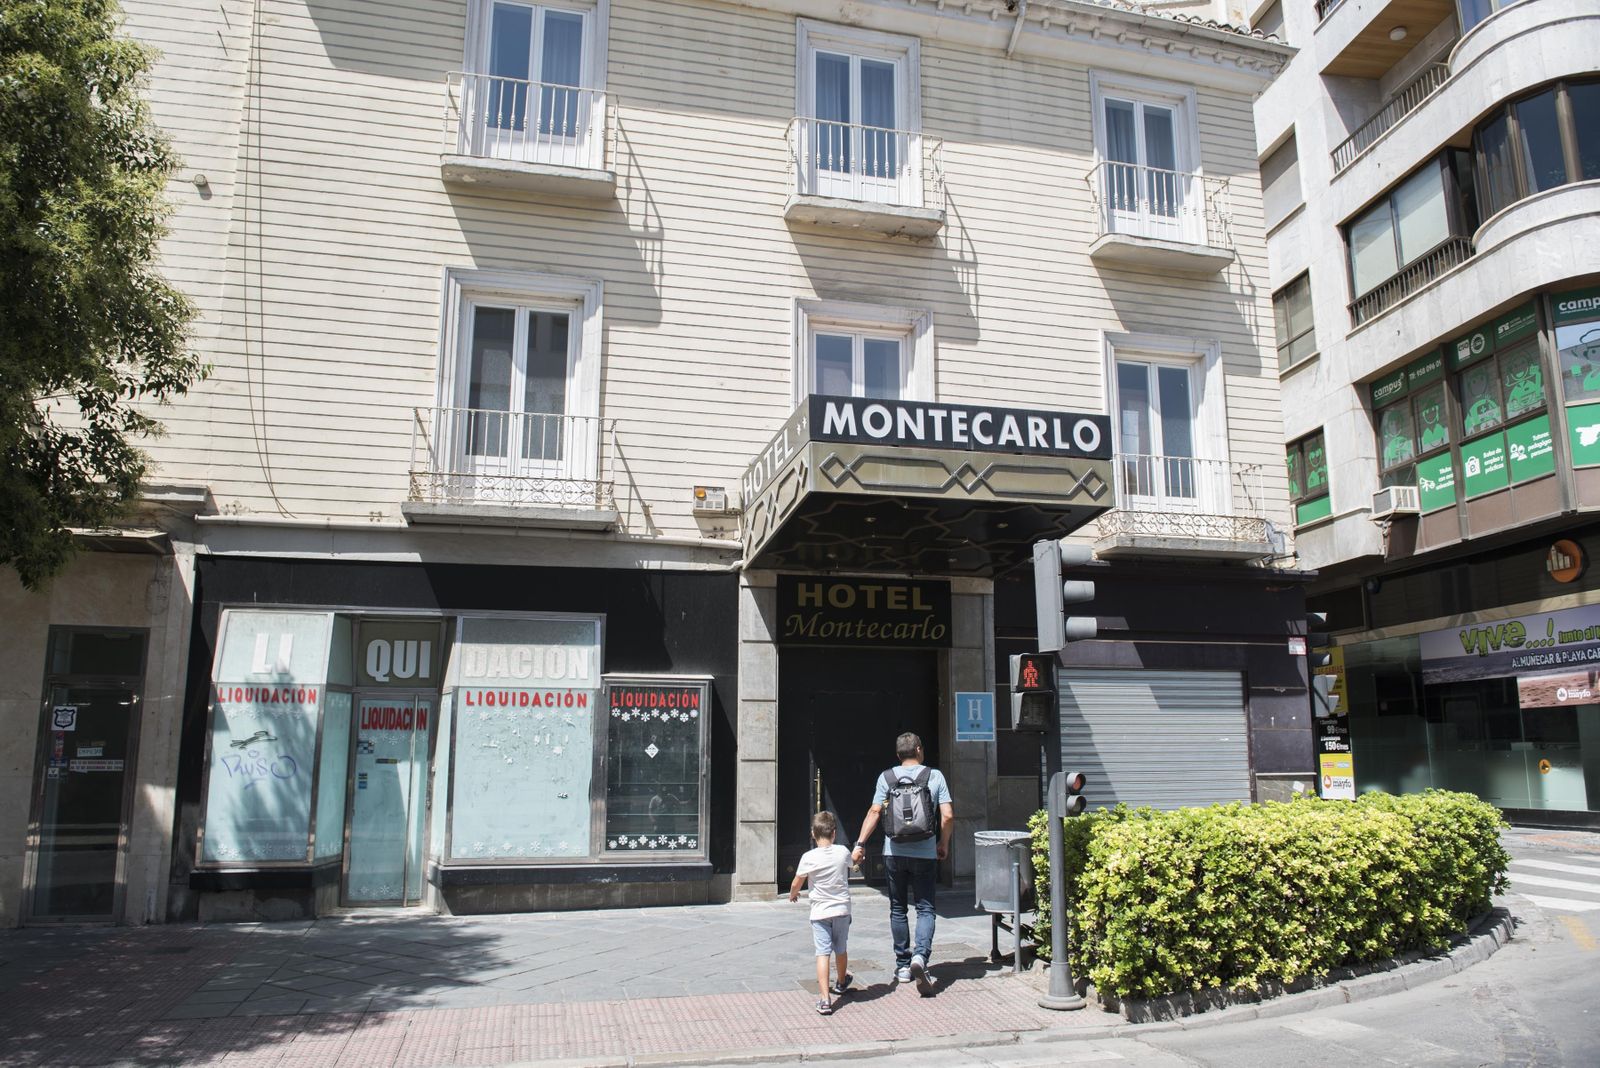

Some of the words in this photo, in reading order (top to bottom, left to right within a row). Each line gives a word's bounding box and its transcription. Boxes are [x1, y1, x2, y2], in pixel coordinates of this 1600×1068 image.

[1374, 379, 1403, 398] campus
[822, 402, 1101, 452] MONTECARLO
[743, 428, 794, 506] HOTEL
[798, 583, 932, 610] HOTEL
[785, 612, 945, 640] Montecarlo
[252, 633, 294, 674] LI
[366, 639, 431, 682] QUI
[464, 642, 589, 680] DACIÓN
[1555, 652, 1562, 664] &
[1562, 649, 1587, 663] PLAYA
[217, 684, 317, 704] LIQUIDACIÓN
[466, 688, 587, 708] LIQUIDACIÓN
[611, 689, 699, 708] LIQUIDACIÓN
[361, 706, 428, 730] LIQUIDACIN
[968, 699, 983, 720] H
[1325, 741, 1337, 751] 150
